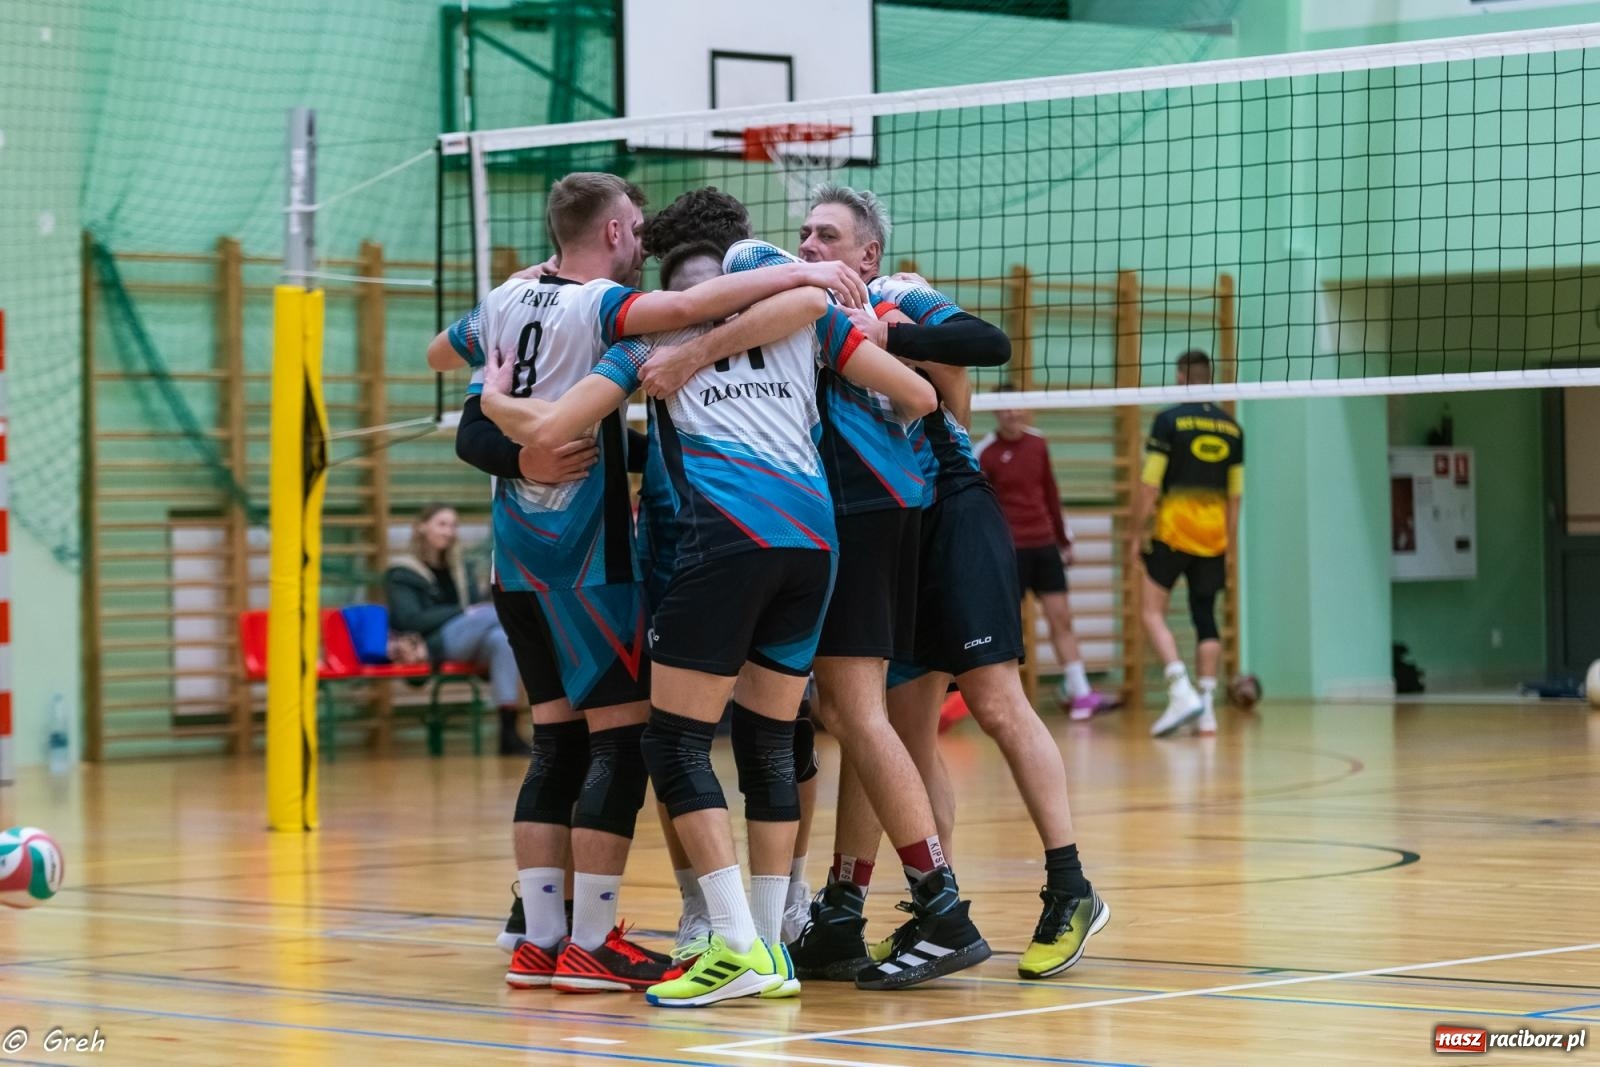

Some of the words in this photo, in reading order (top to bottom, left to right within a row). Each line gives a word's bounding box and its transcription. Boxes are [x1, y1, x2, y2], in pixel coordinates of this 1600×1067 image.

[510, 321, 543, 398] 8
[700, 381, 793, 407] ZŁOTNIK
[964, 636, 992, 650] COLO
